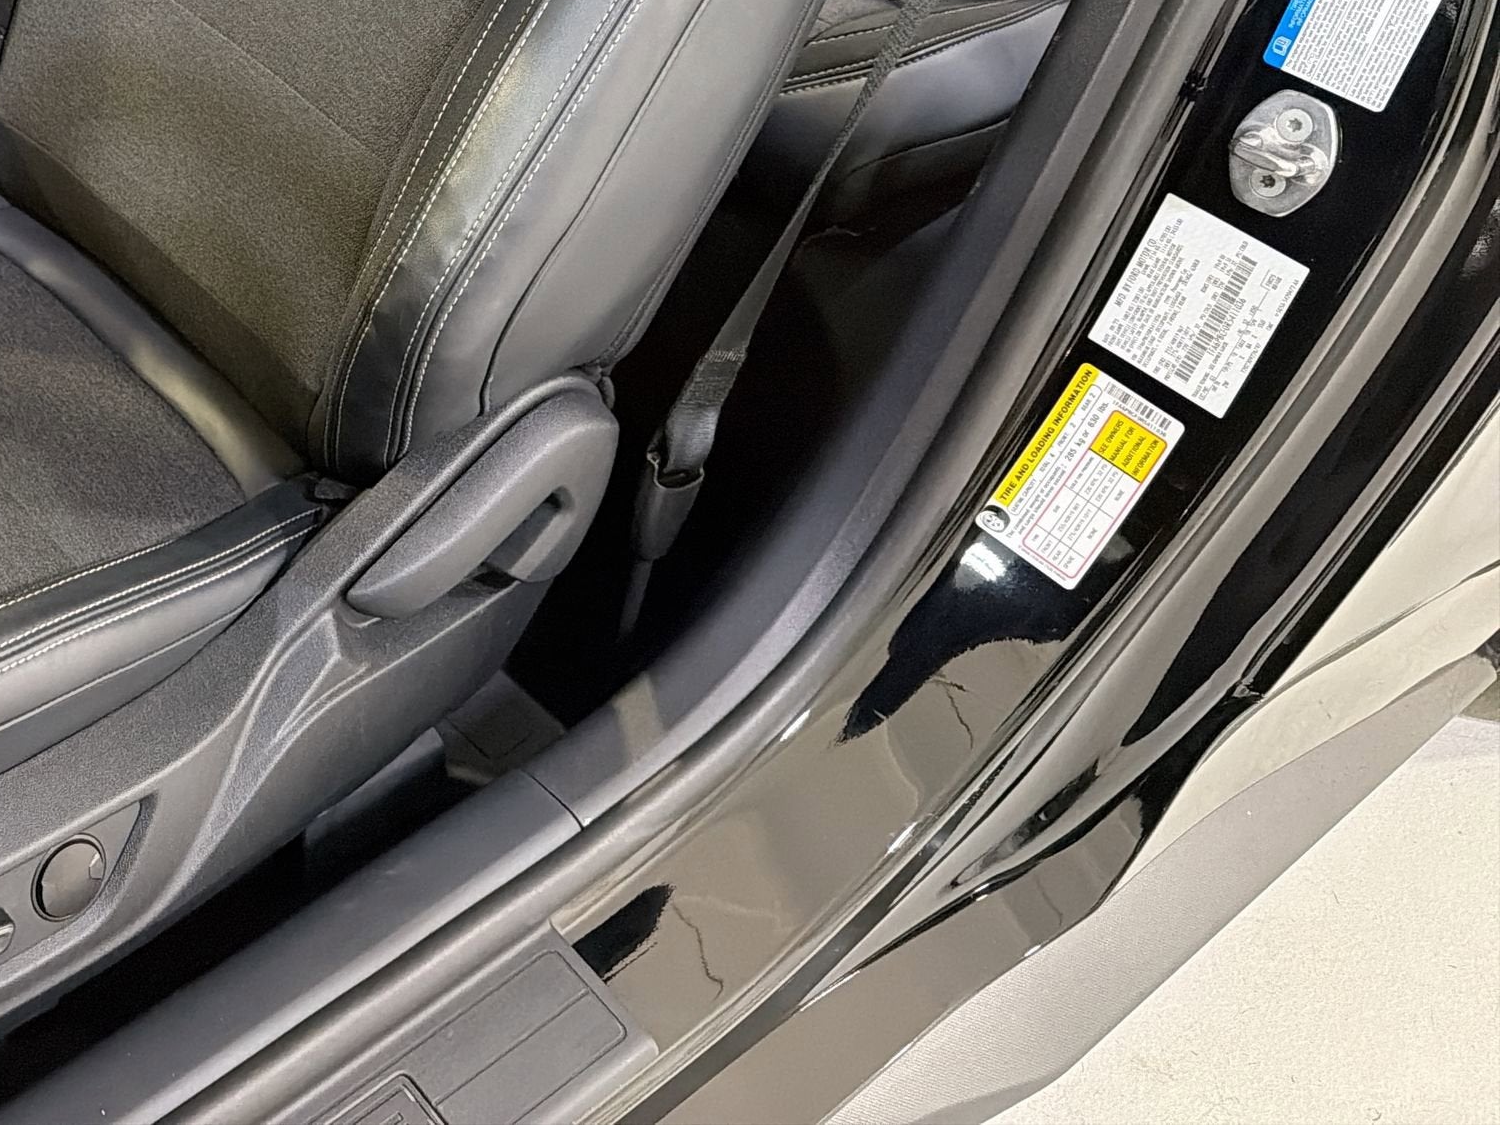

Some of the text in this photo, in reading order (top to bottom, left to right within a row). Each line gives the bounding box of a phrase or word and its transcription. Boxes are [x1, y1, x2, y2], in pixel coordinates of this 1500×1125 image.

[1134, 245, 1152, 268] MOTOR
[1121, 282, 1132, 292] BY
[1125, 266, 1141, 285] FORD
[999, 368, 1094, 502] TIRE AND LOADING INFORMATION
[1063, 399, 1109, 462] 285 kg or 630 lbs.
[1097, 418, 1125, 454] SEE OWNERS
[1109, 425, 1136, 462] MANUAL FOR
[1121, 434, 1146, 468] ADDITIONAL
[1131, 438, 1160, 476] INFORMATION
